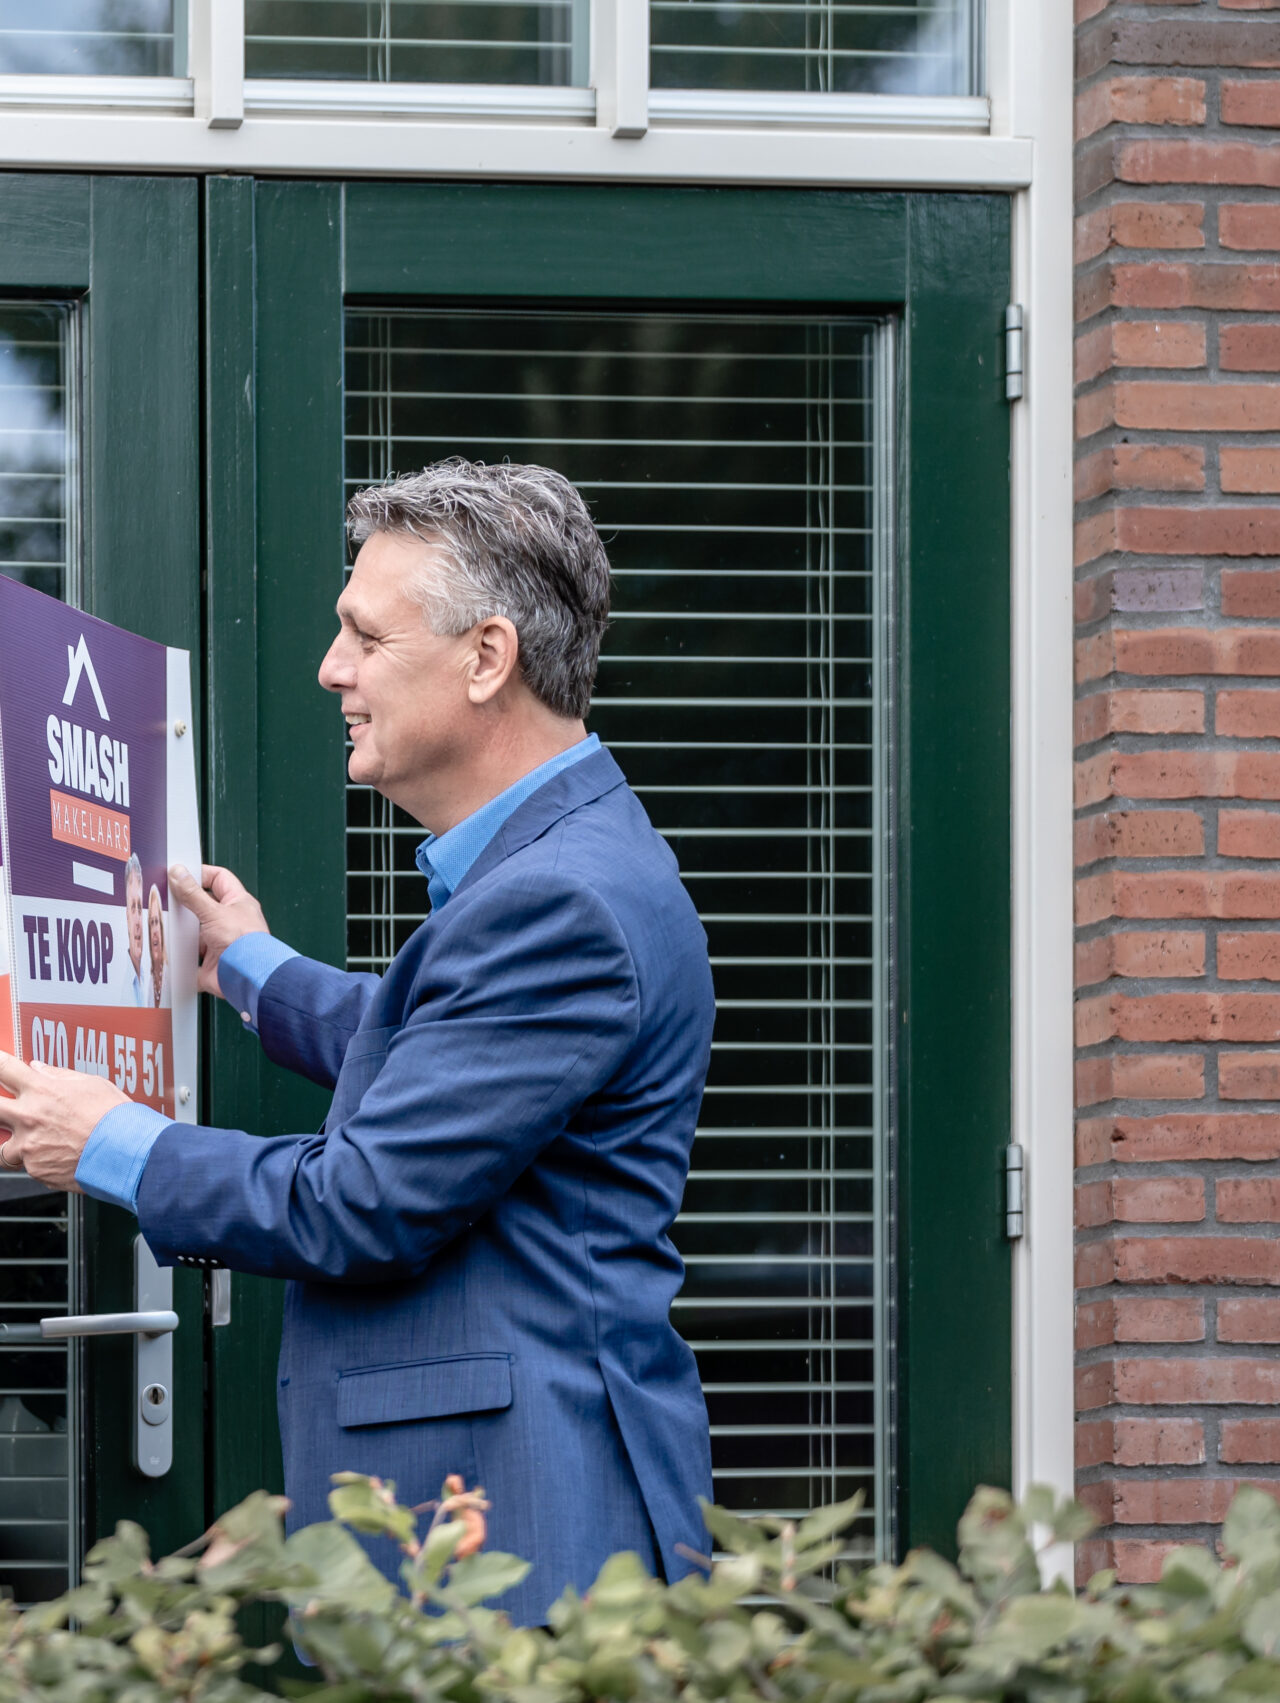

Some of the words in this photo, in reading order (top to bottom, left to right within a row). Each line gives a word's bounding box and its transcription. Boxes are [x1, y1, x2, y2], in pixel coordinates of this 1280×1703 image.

[46, 713, 130, 808] SMASH
[51, 799, 130, 853] MAKELAARS
[22, 914, 52, 980] TE
[56, 917, 114, 985] KOOP
[31, 1016, 69, 1070] 070
[74, 1026, 110, 1081] 444
[114, 1034, 138, 1095] 55
[142, 1039, 165, 1098] 51
